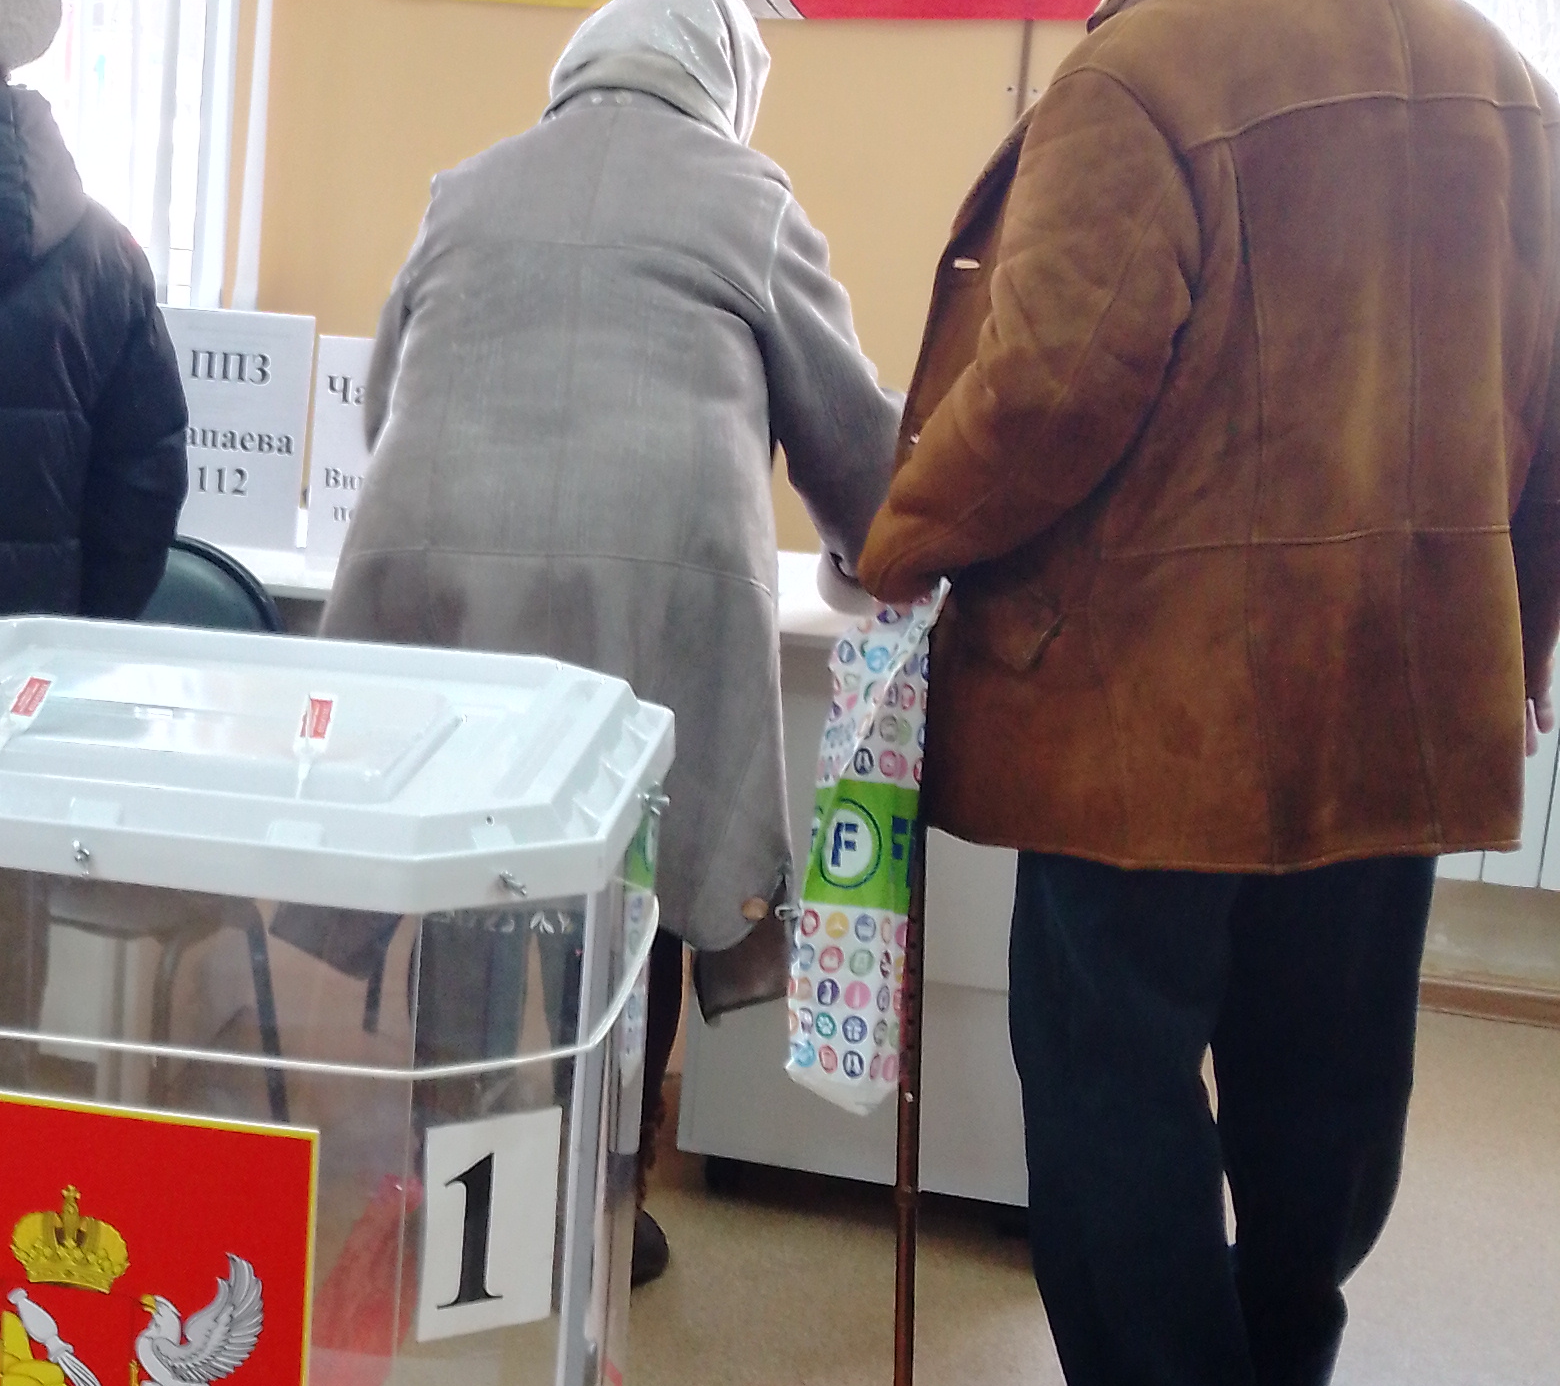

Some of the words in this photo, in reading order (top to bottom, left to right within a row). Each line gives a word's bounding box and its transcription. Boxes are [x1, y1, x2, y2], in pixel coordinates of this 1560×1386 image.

[198, 465, 248, 497] 112
[831, 822, 858, 867] F
[437, 1152, 503, 1310] 1
